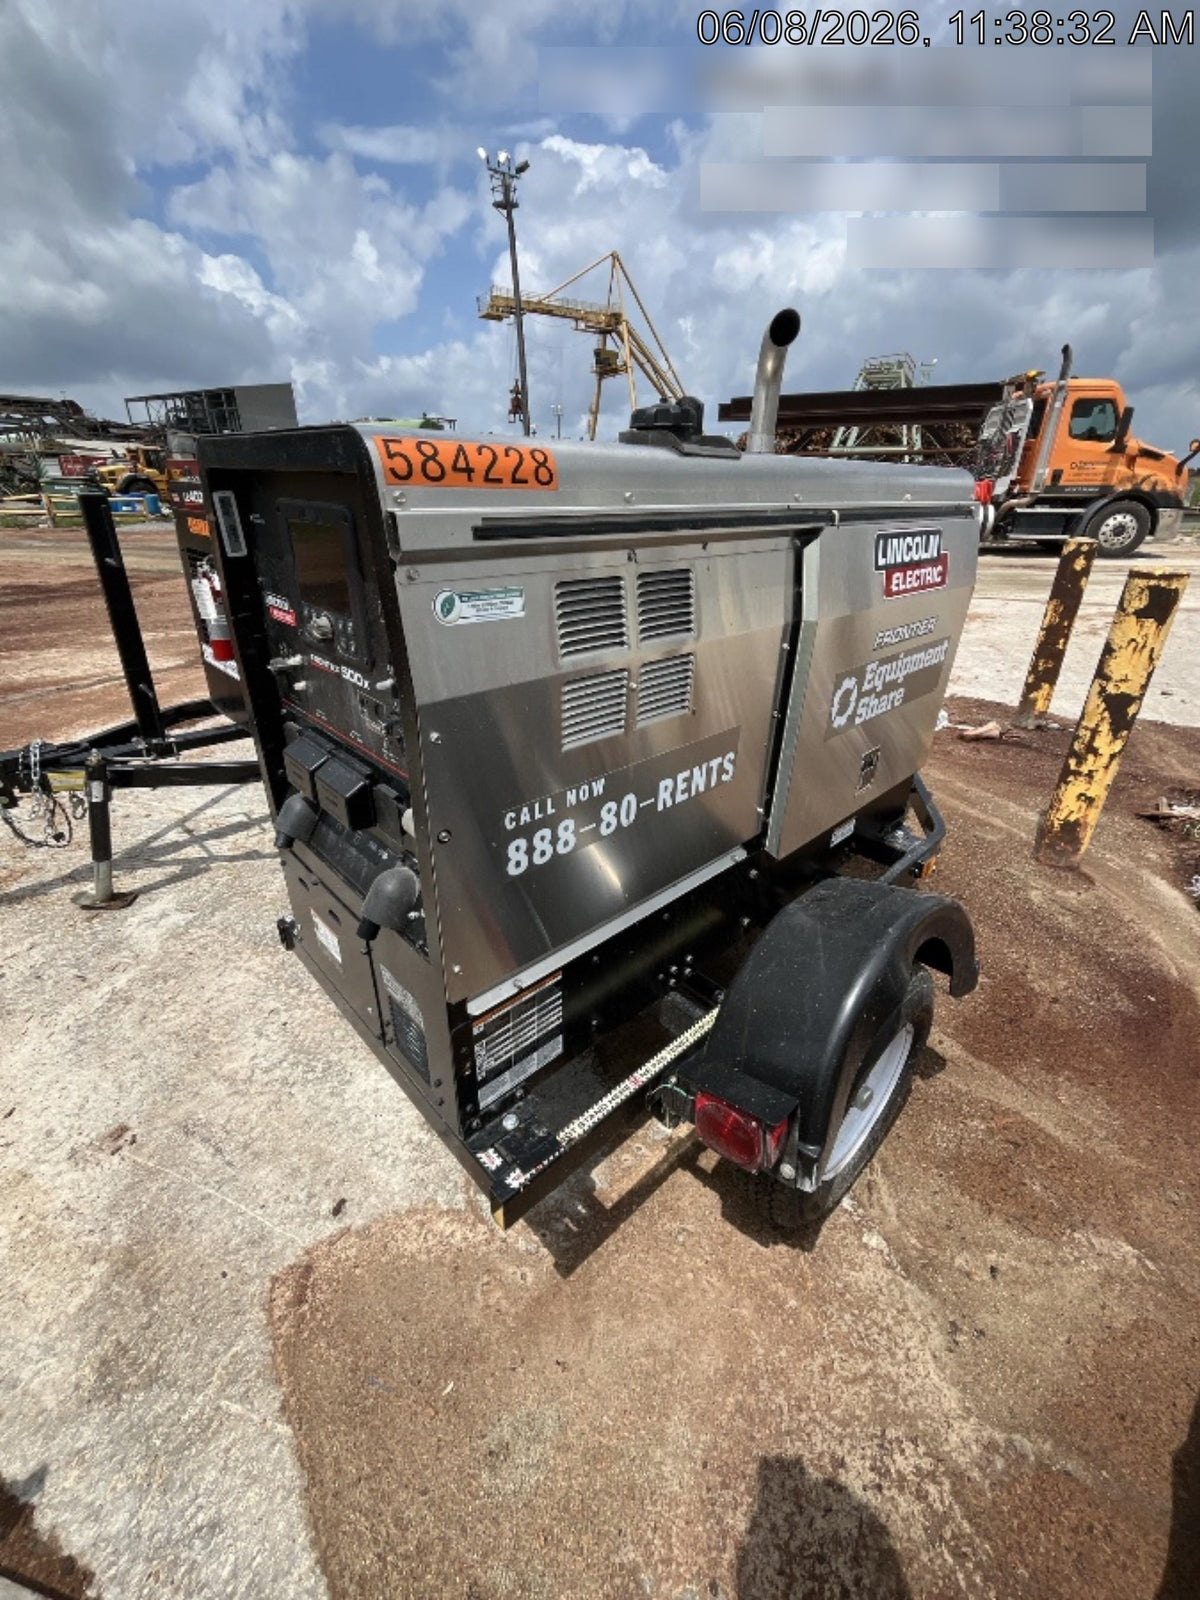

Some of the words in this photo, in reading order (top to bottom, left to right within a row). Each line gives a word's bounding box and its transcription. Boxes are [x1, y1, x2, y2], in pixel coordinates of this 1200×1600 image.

[381, 438, 554, 487] 584228
[877, 533, 941, 567] LINCOLN
[890, 565, 943, 592] ELECTRIC
[861, 639, 949, 693] Equipment
[855, 686, 905, 726] Share
[504, 797, 556, 831] CALL
[566, 777, 606, 808] NOW
[505, 751, 736, 877] 888-80-RENTS
